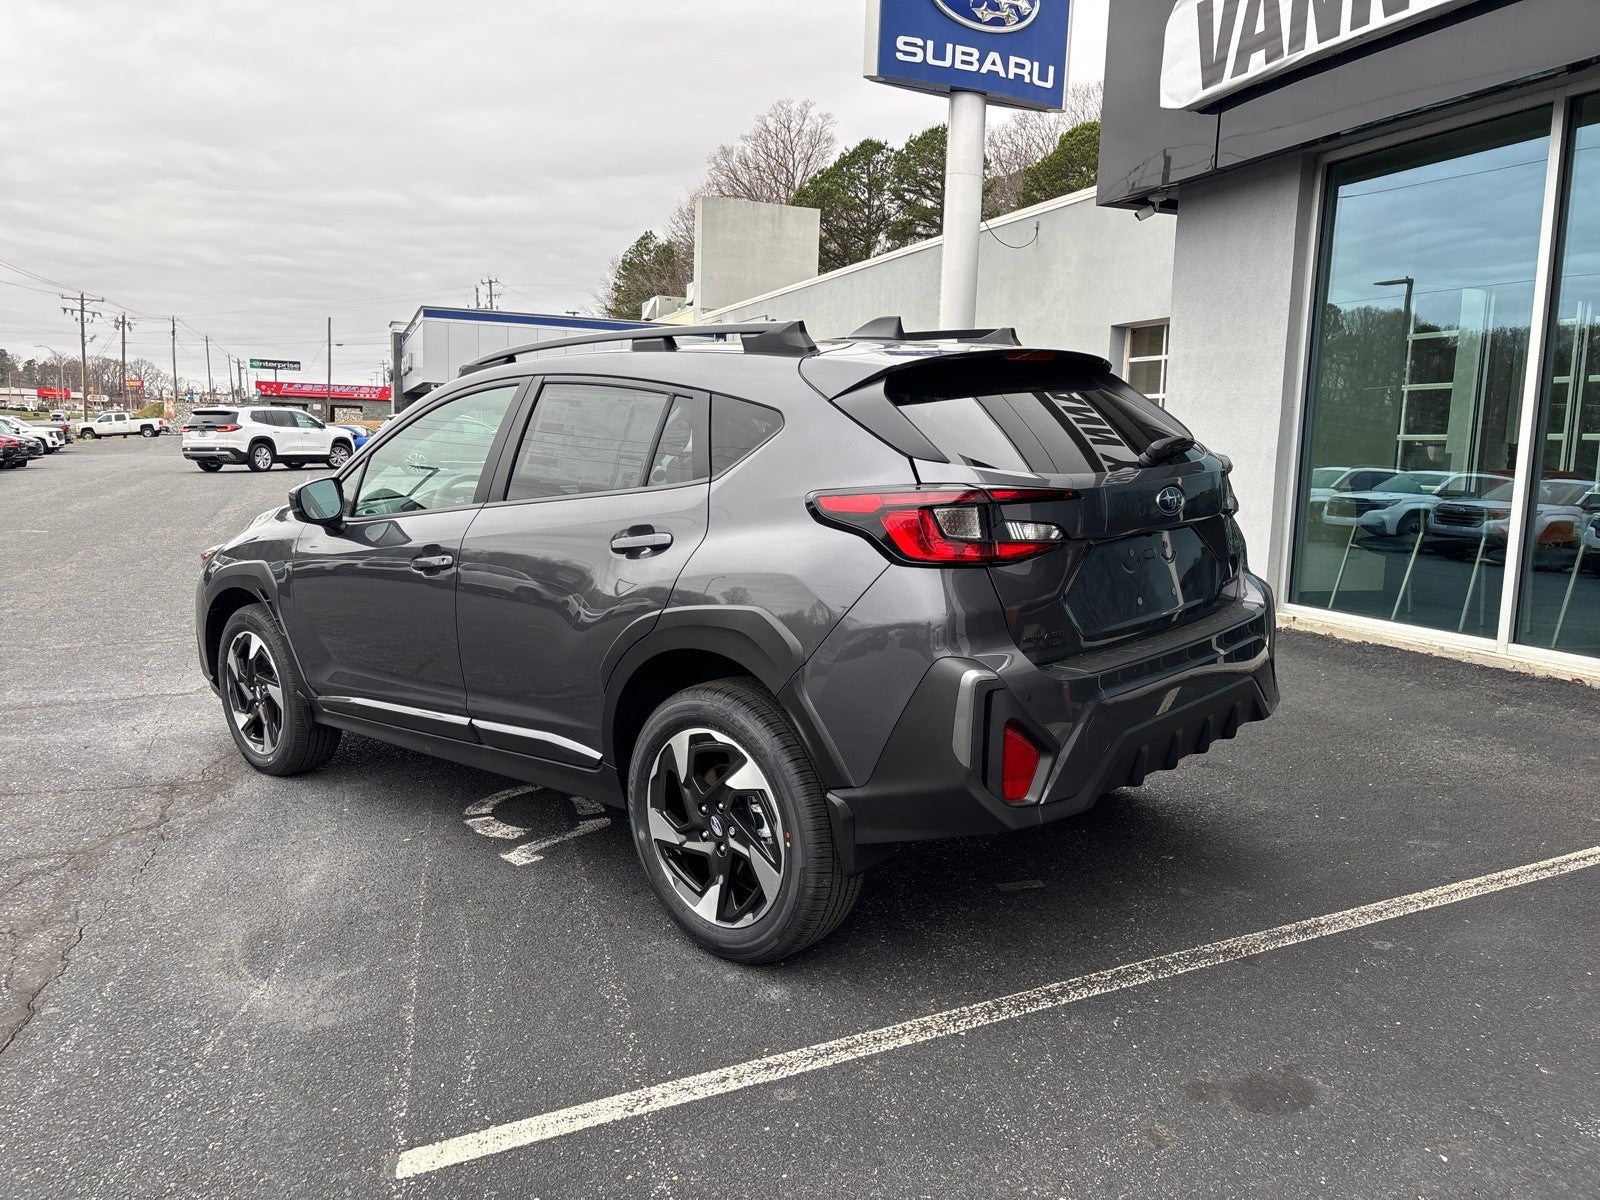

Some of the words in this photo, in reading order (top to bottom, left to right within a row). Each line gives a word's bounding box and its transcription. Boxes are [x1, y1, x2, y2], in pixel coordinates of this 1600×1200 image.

[896, 35, 1055, 89] SUBARU
[1197, 0, 1410, 90] VAN
[252, 360, 300, 369] enterprise
